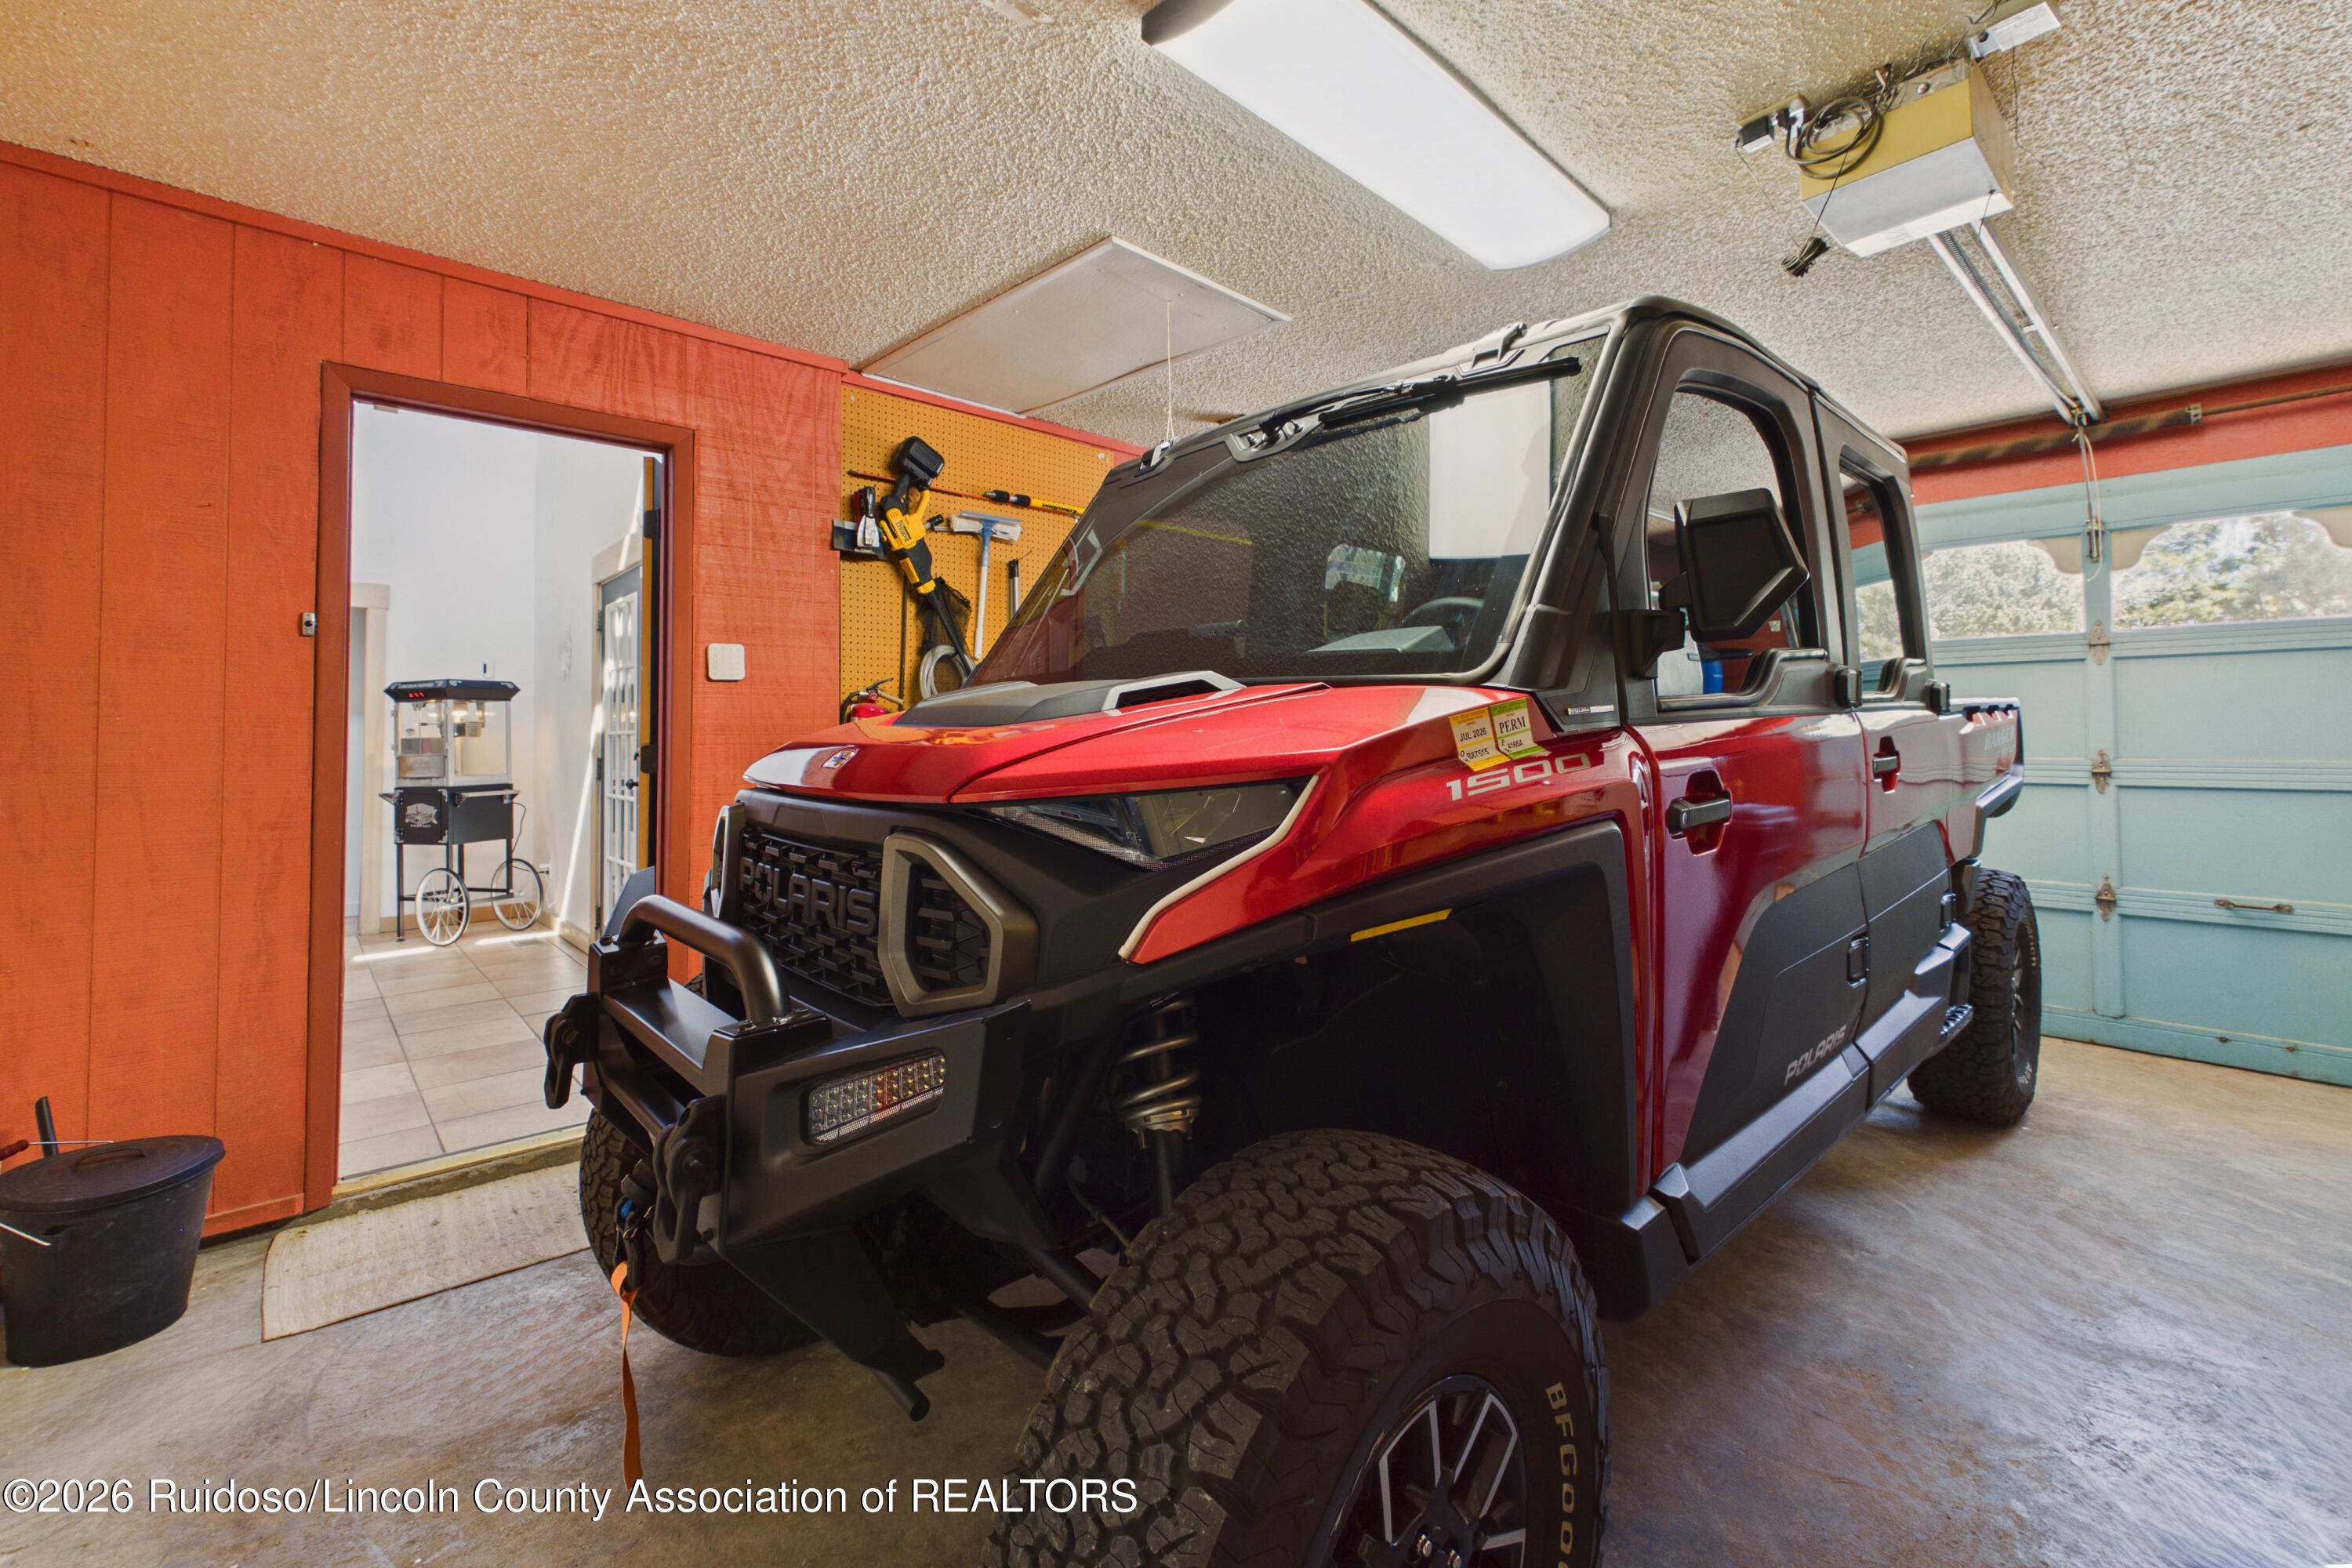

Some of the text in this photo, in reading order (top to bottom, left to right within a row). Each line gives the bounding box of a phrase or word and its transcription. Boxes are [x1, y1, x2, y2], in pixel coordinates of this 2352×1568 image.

[1460, 727, 1487, 742] JUL 2026
[1498, 717, 1526, 735] PERM
[1446, 753, 1592, 801] 1500
[740, 855, 877, 935] POLARIS
[1784, 1024, 1847, 1086] POLARIS
[1545, 1381, 1577, 1568] BFGOO
